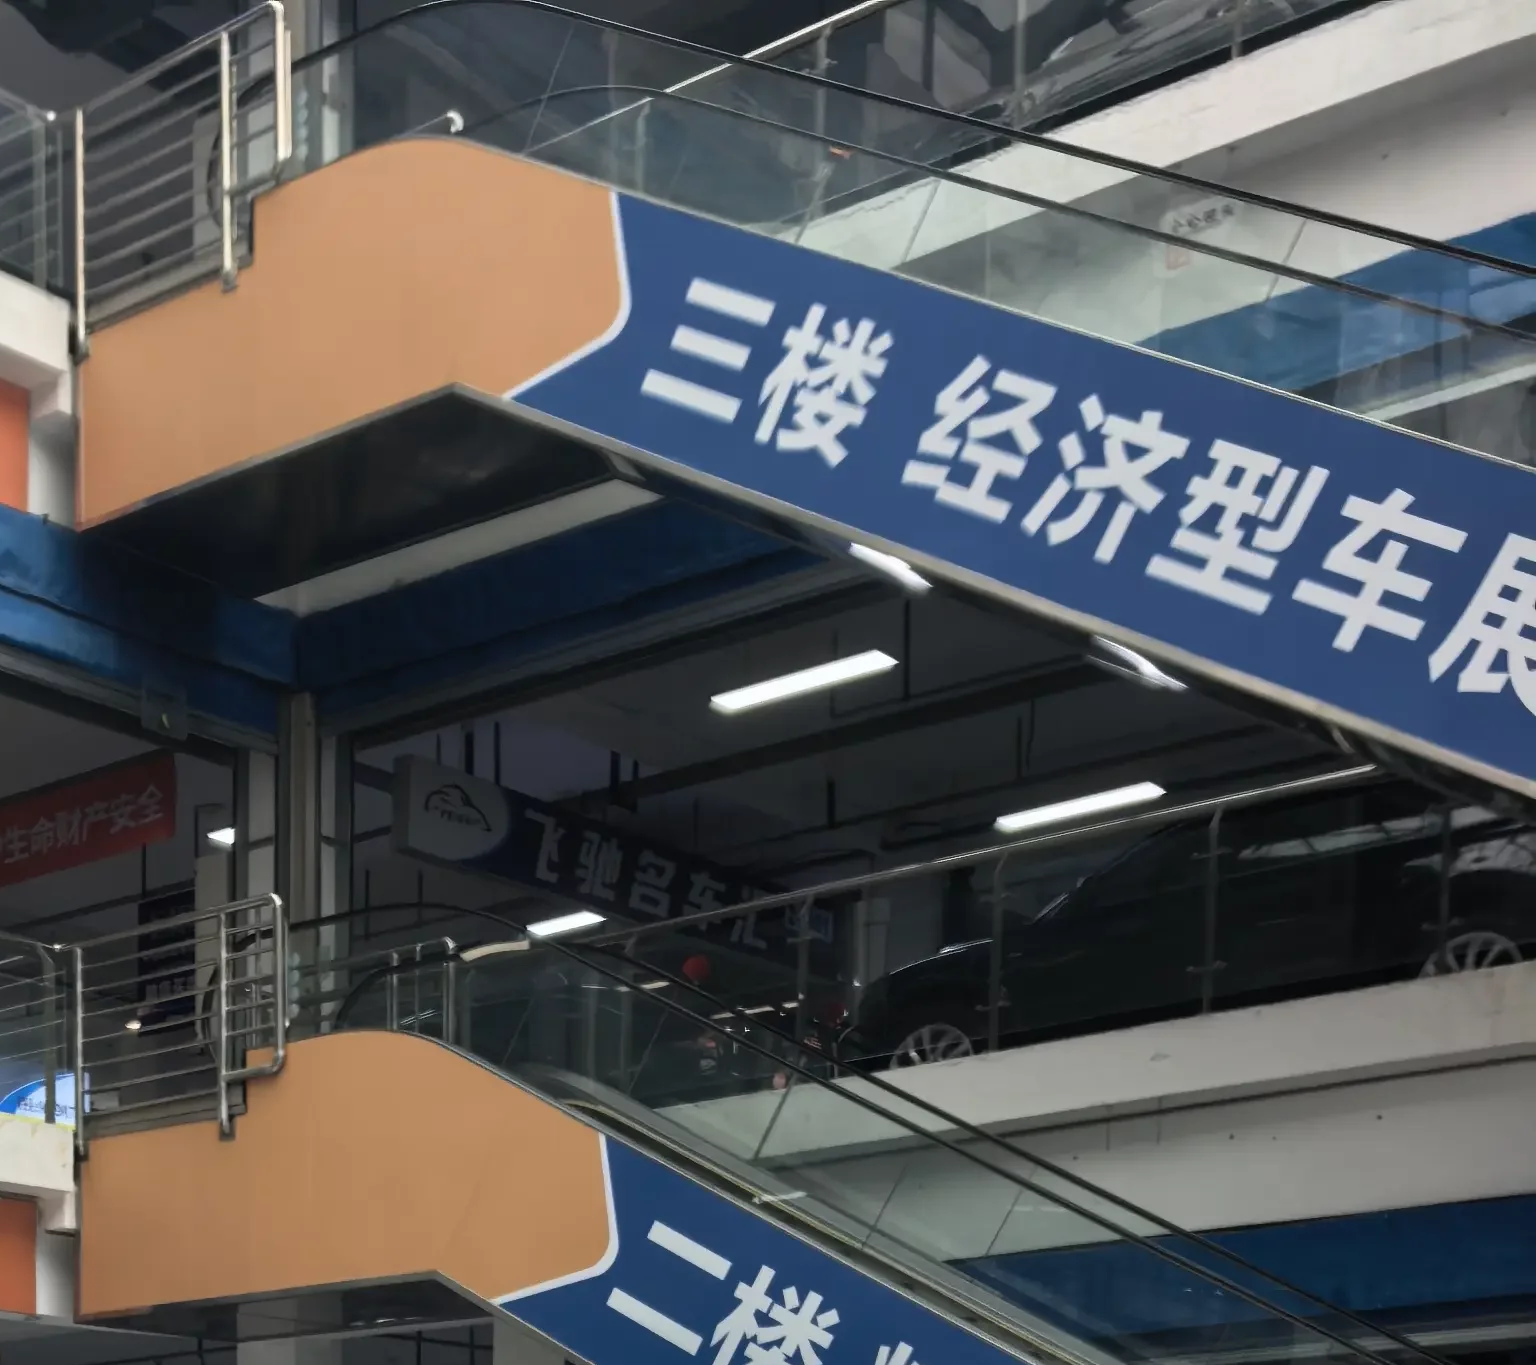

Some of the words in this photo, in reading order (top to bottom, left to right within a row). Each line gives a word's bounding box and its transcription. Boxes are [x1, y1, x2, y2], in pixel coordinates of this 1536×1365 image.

[641, 277, 895, 468] 三楼
[902, 354, 1536, 718] 经济型车展
